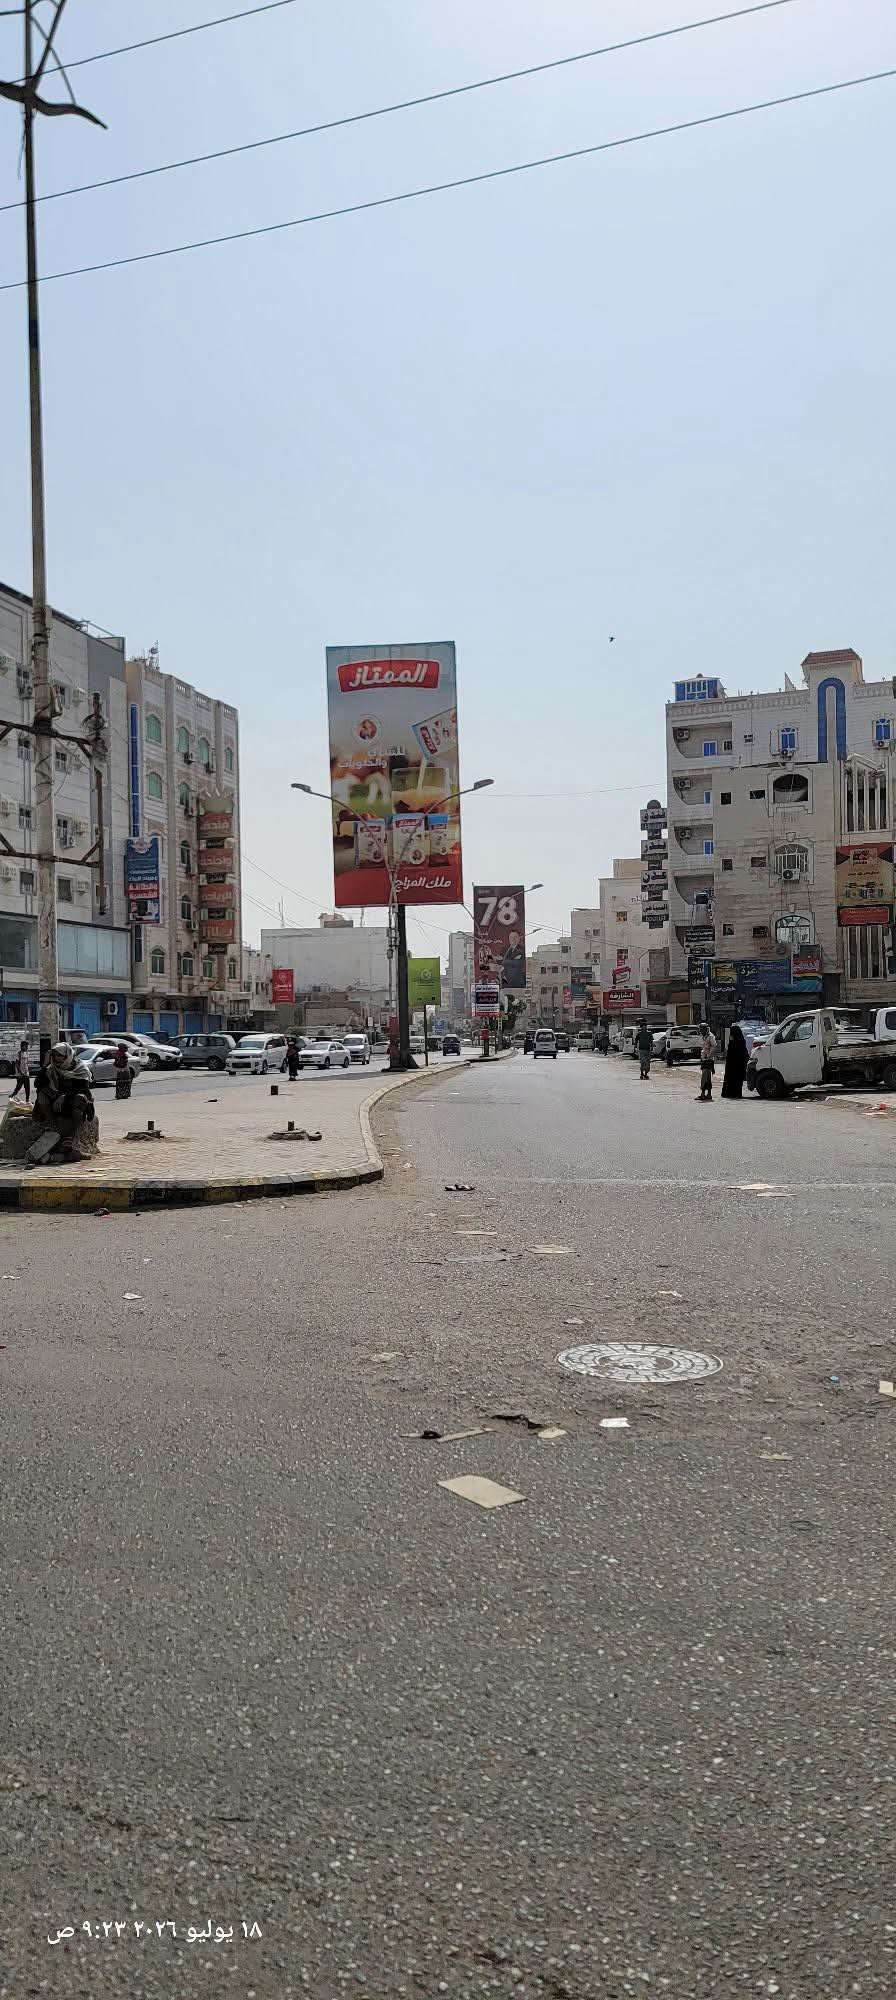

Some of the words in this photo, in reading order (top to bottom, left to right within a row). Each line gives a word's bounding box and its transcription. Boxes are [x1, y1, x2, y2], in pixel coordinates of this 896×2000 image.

[348, 663, 428, 688] الممتاز
[394, 876, 426, 893] المزاج
[425, 876, 452, 889] ملك
[477, 896, 519, 926] 78
